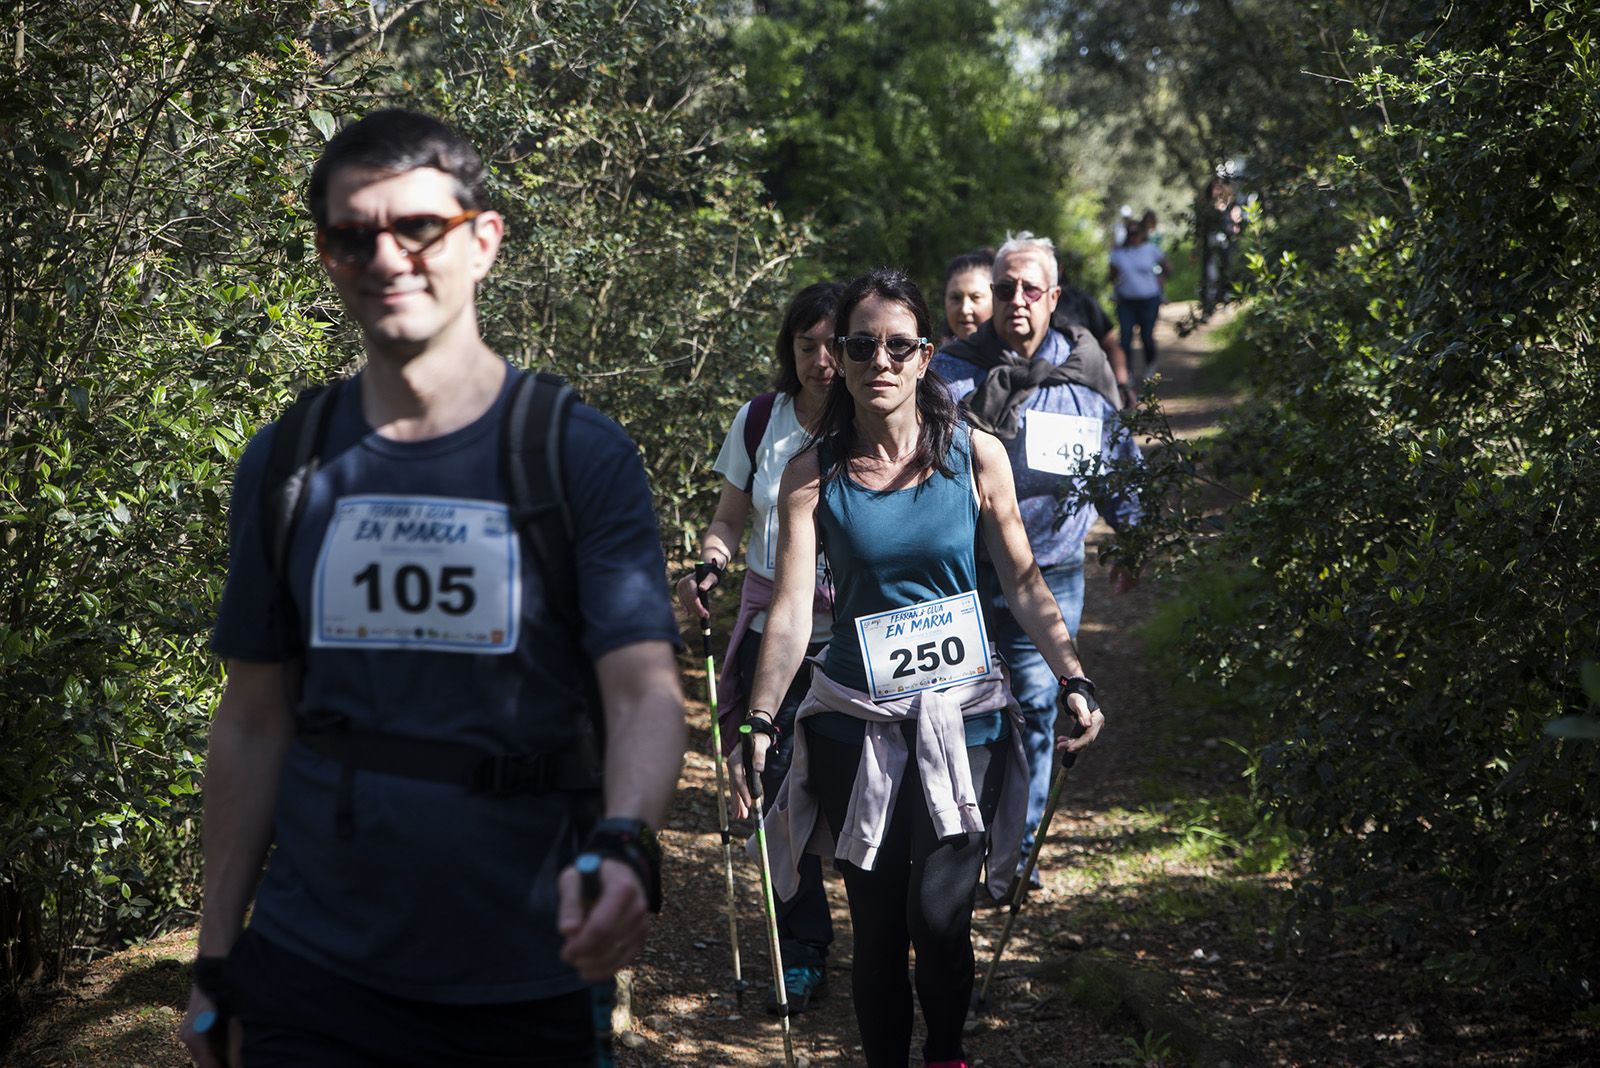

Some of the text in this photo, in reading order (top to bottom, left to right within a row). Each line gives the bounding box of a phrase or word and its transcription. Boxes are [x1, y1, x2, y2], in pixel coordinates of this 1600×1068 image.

[353, 519, 384, 541] EN
[392, 521, 467, 544] MARXA
[354, 562, 476, 616] 105
[927, 604, 944, 615] CLUA
[885, 622, 905, 639] EN
[911, 611, 952, 632] MARXA
[889, 636, 965, 679] 250
